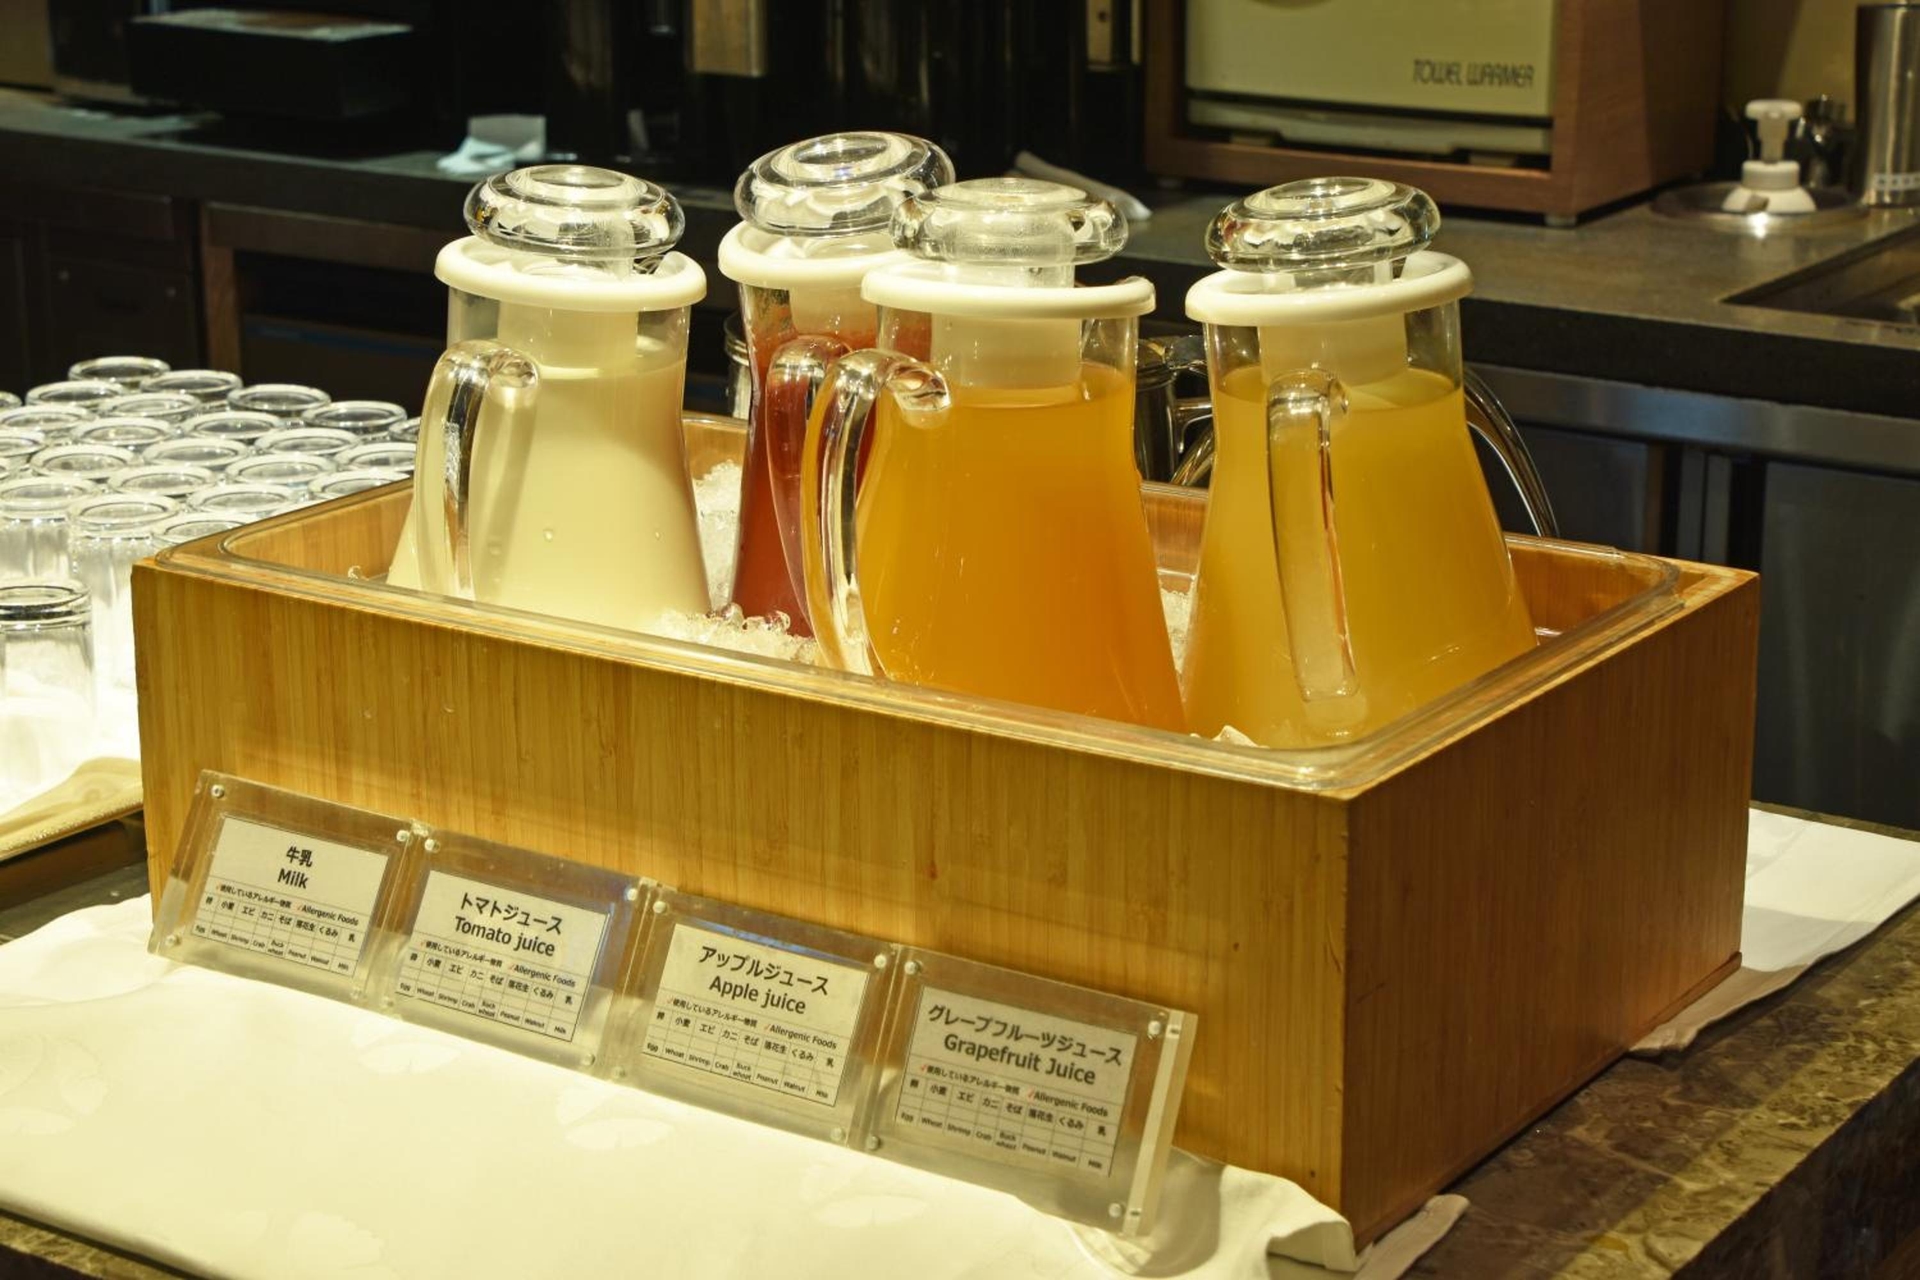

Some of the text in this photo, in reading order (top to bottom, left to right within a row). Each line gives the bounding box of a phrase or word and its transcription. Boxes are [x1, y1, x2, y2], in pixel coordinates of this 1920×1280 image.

[1413, 59, 1534, 88] TOWEL WARMER
[286, 846, 313, 867] 牛乳
[277, 869, 308, 889] Milk
[242, 906, 256, 915] エビ
[261, 911, 275, 921] カニ
[279, 916, 292, 925] そば
[319, 926, 338, 937] くるみ
[302, 905, 359, 926] Allergenic Foods
[461, 893, 563, 934] トマトジュース
[455, 916, 555, 957] Tomato juice
[449, 964, 463, 974] エビ
[471, 970, 484, 980] カニ
[490, 974, 504, 985] そば
[533, 986, 554, 999] くるみ
[514, 965, 575, 987] Allergenic Foods
[699, 946, 828, 995] アップルジュース
[709, 976, 806, 1014] Apple juice
[700, 1023, 716, 1034] エビ
[722, 1029, 738, 1041] カニ
[744, 1034, 759, 1046] そば
[791, 1048, 814, 1062] くるみ
[769, 1024, 837, 1049] Allergenic Foods
[928, 1004, 1122, 1066] グレープフルーツジュース
[944, 1034, 1095, 1085] Grapefruit Juice
[958, 1091, 974, 1104] エビ
[983, 1097, 998, 1109] カニ
[1006, 1103, 1022, 1115] そば
[1058, 1116, 1084, 1130] くるみ
[1034, 1091, 1108, 1117] Allergenic Foods
